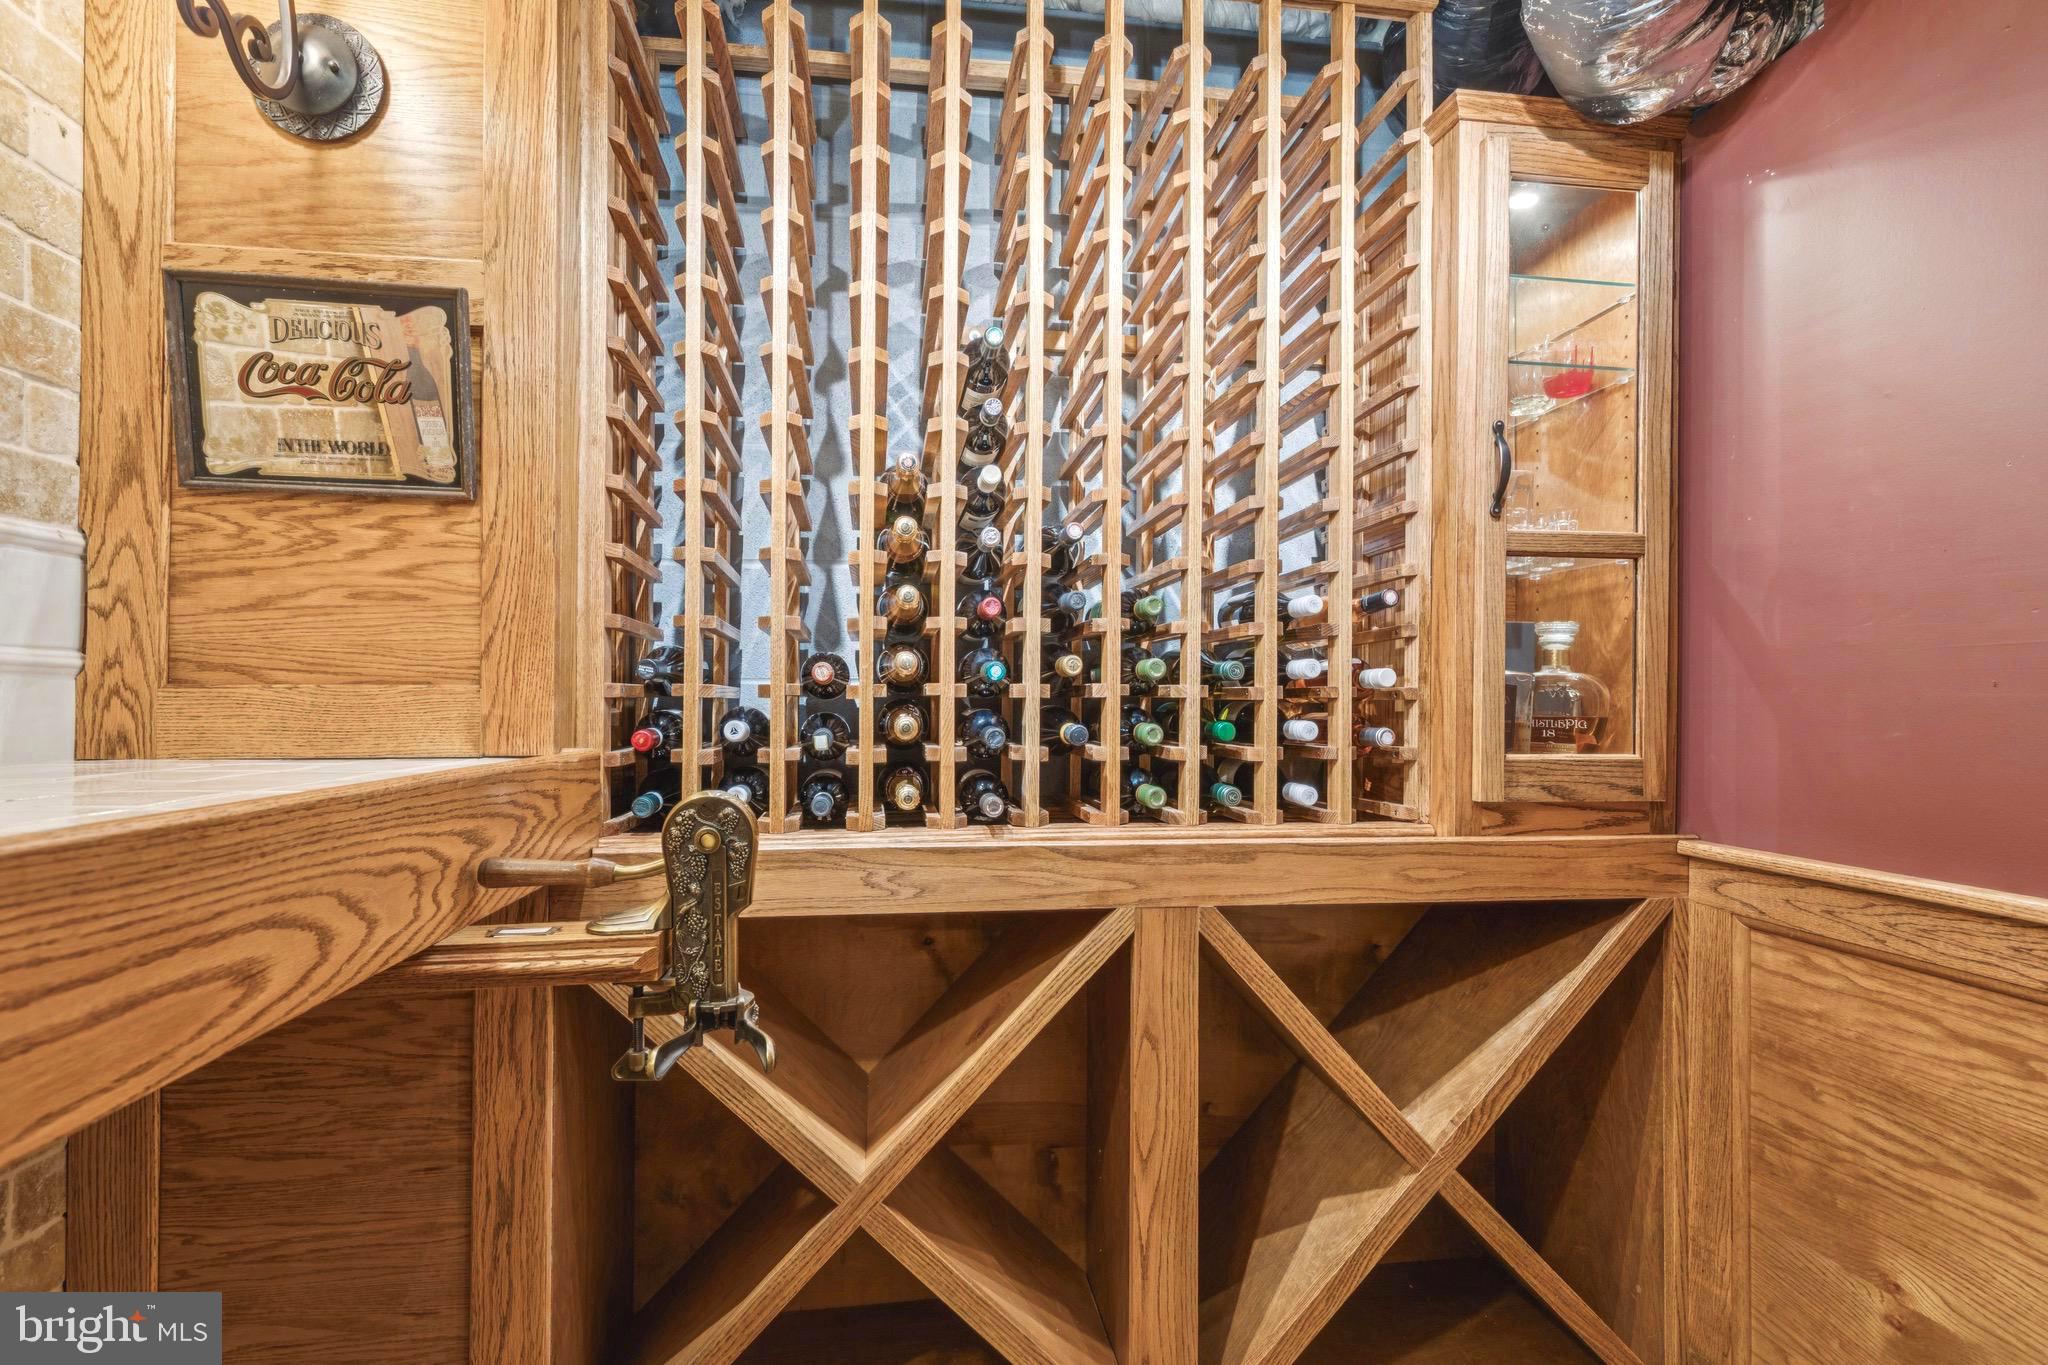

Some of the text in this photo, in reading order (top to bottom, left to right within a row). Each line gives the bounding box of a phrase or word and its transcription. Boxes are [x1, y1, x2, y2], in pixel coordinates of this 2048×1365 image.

[268, 316, 382, 349] DELICIOUS
[277, 438, 294, 452] IN
[1530, 719, 1587, 729] HISTLEPIG
[1542, 729, 1556, 737] 18
[713, 882, 722, 971] ESTATE
